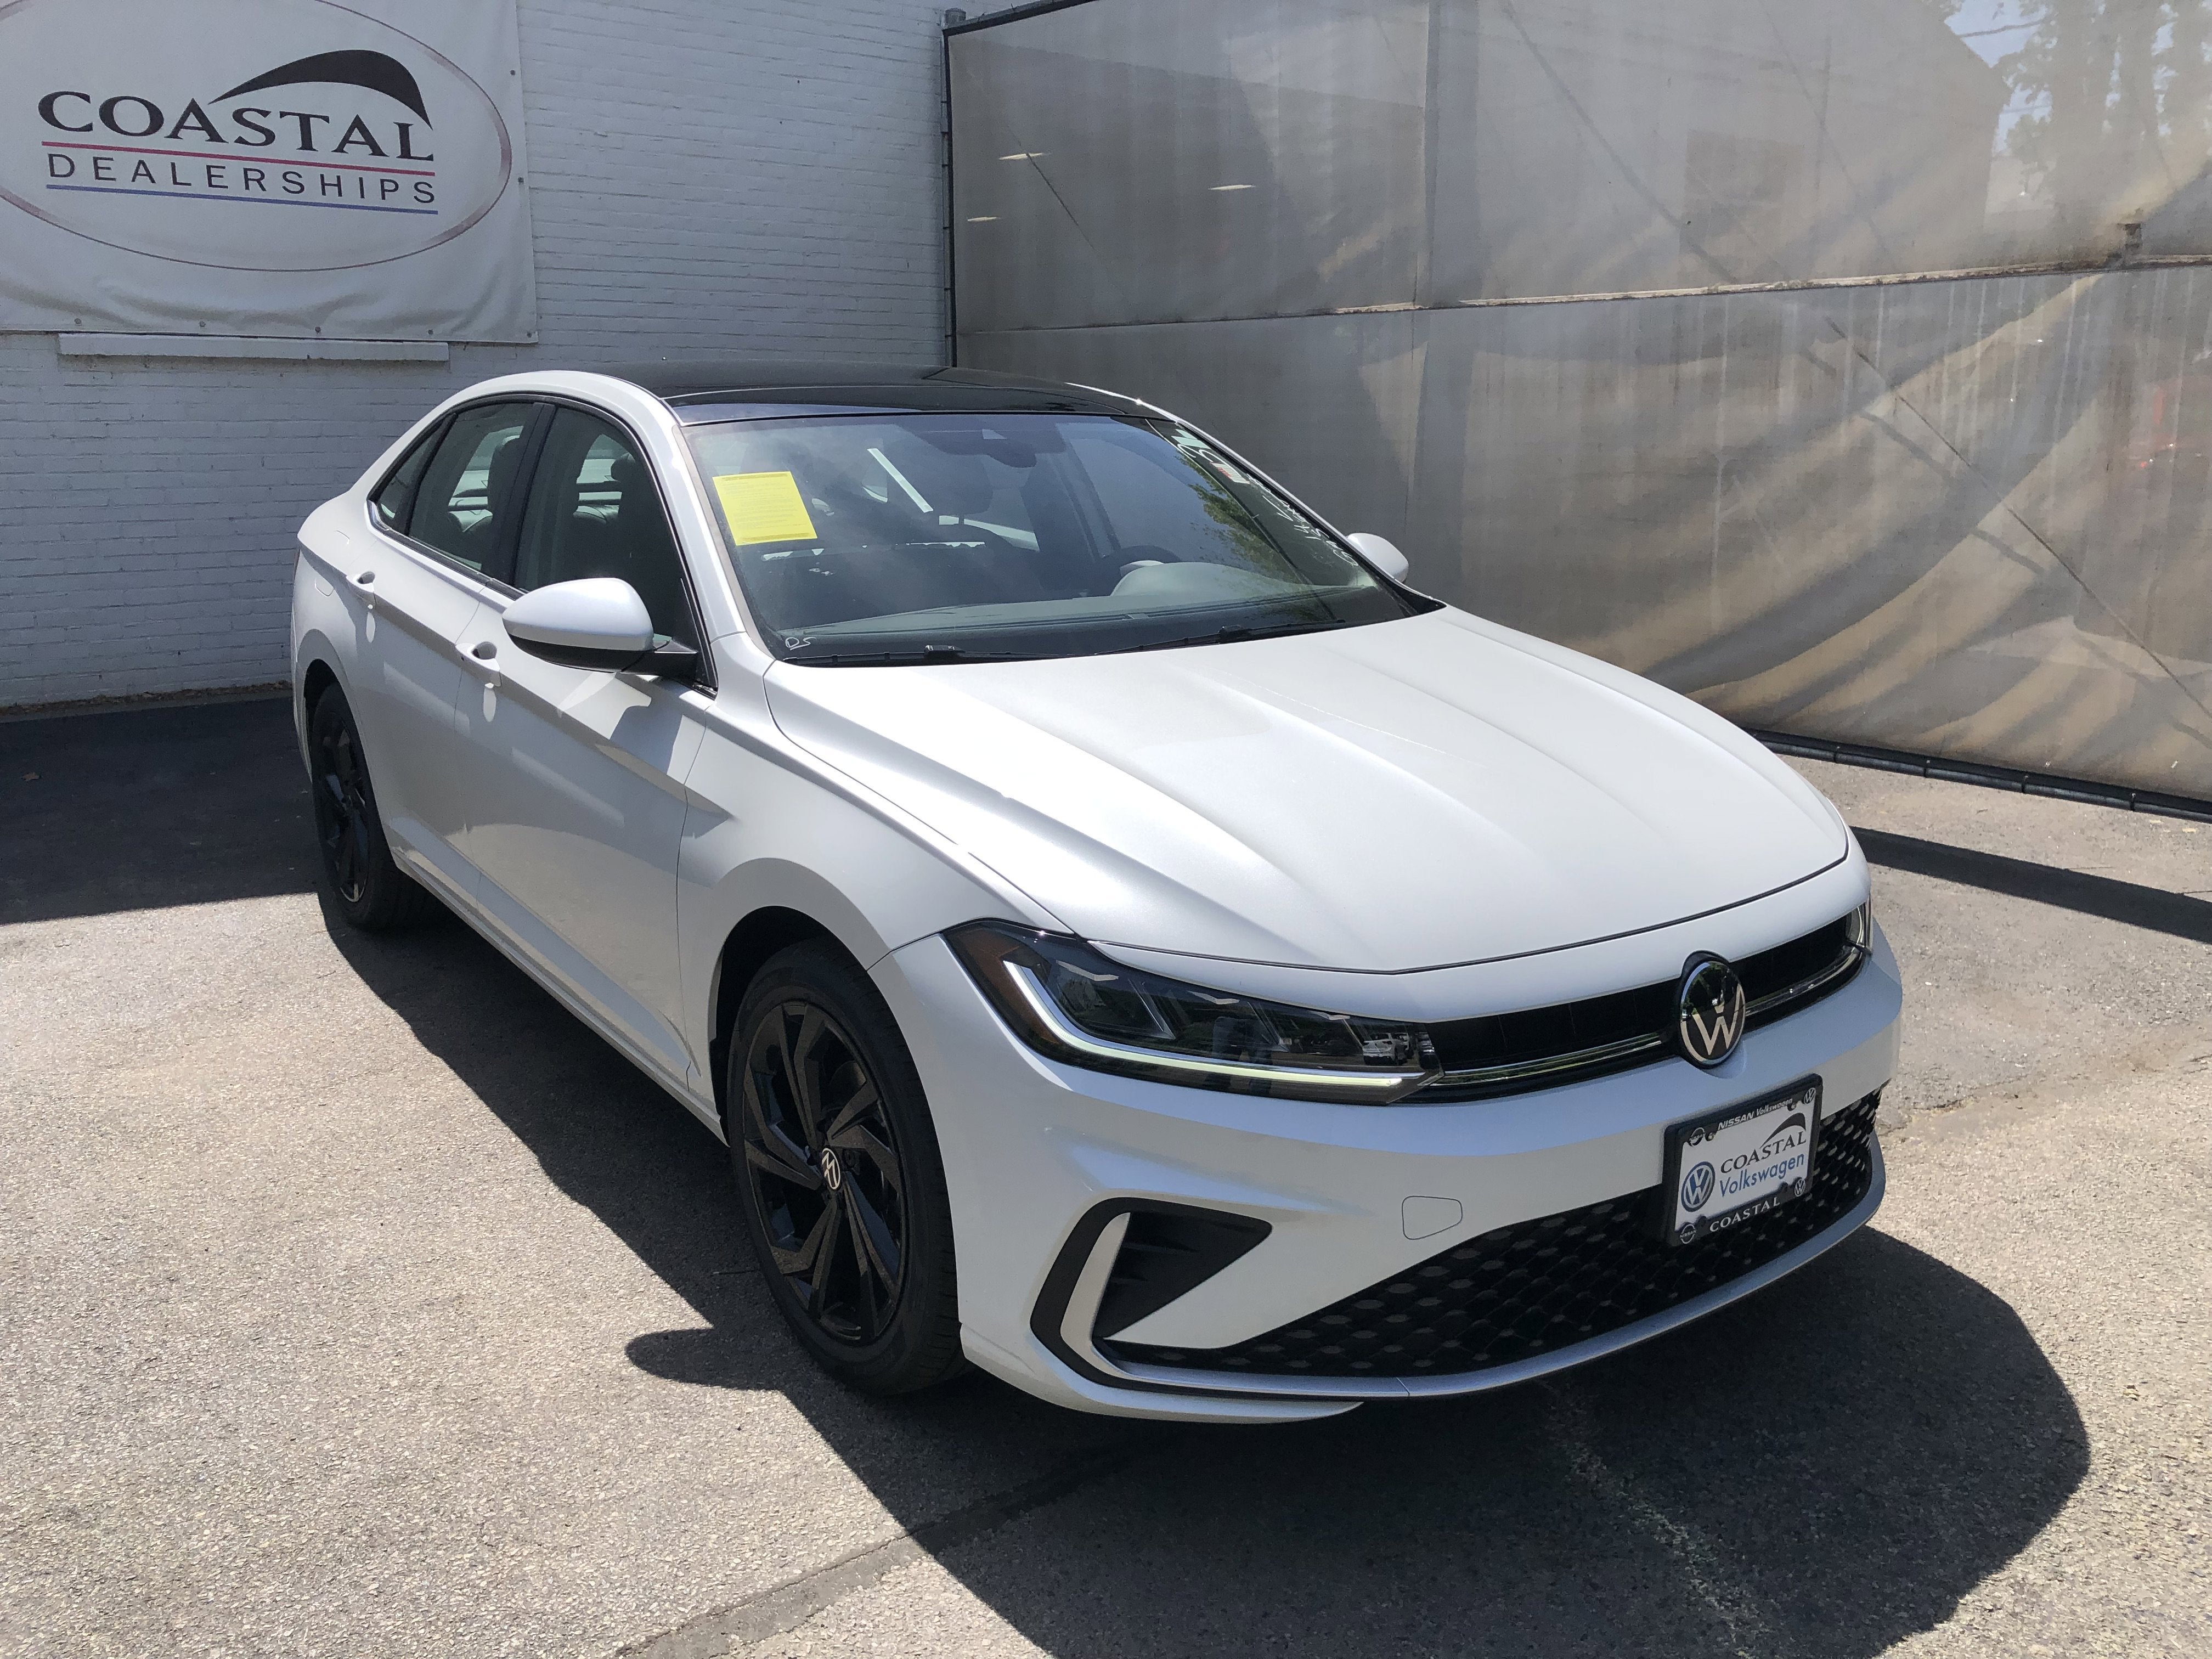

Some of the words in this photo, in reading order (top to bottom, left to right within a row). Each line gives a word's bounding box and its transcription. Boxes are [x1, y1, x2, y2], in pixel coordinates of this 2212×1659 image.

[38, 91, 435, 162] COASTAL
[48, 153, 435, 204] DEALERSHIPS
[1717, 1111, 1754, 1131] NISSAN
[1756, 1098, 1793, 1116] Volkswagen
[1720, 1131, 1807, 1173] COASTAL
[1719, 1153, 1804, 1198] Volkswagen
[1709, 1197, 1780, 1232] COASTAL
